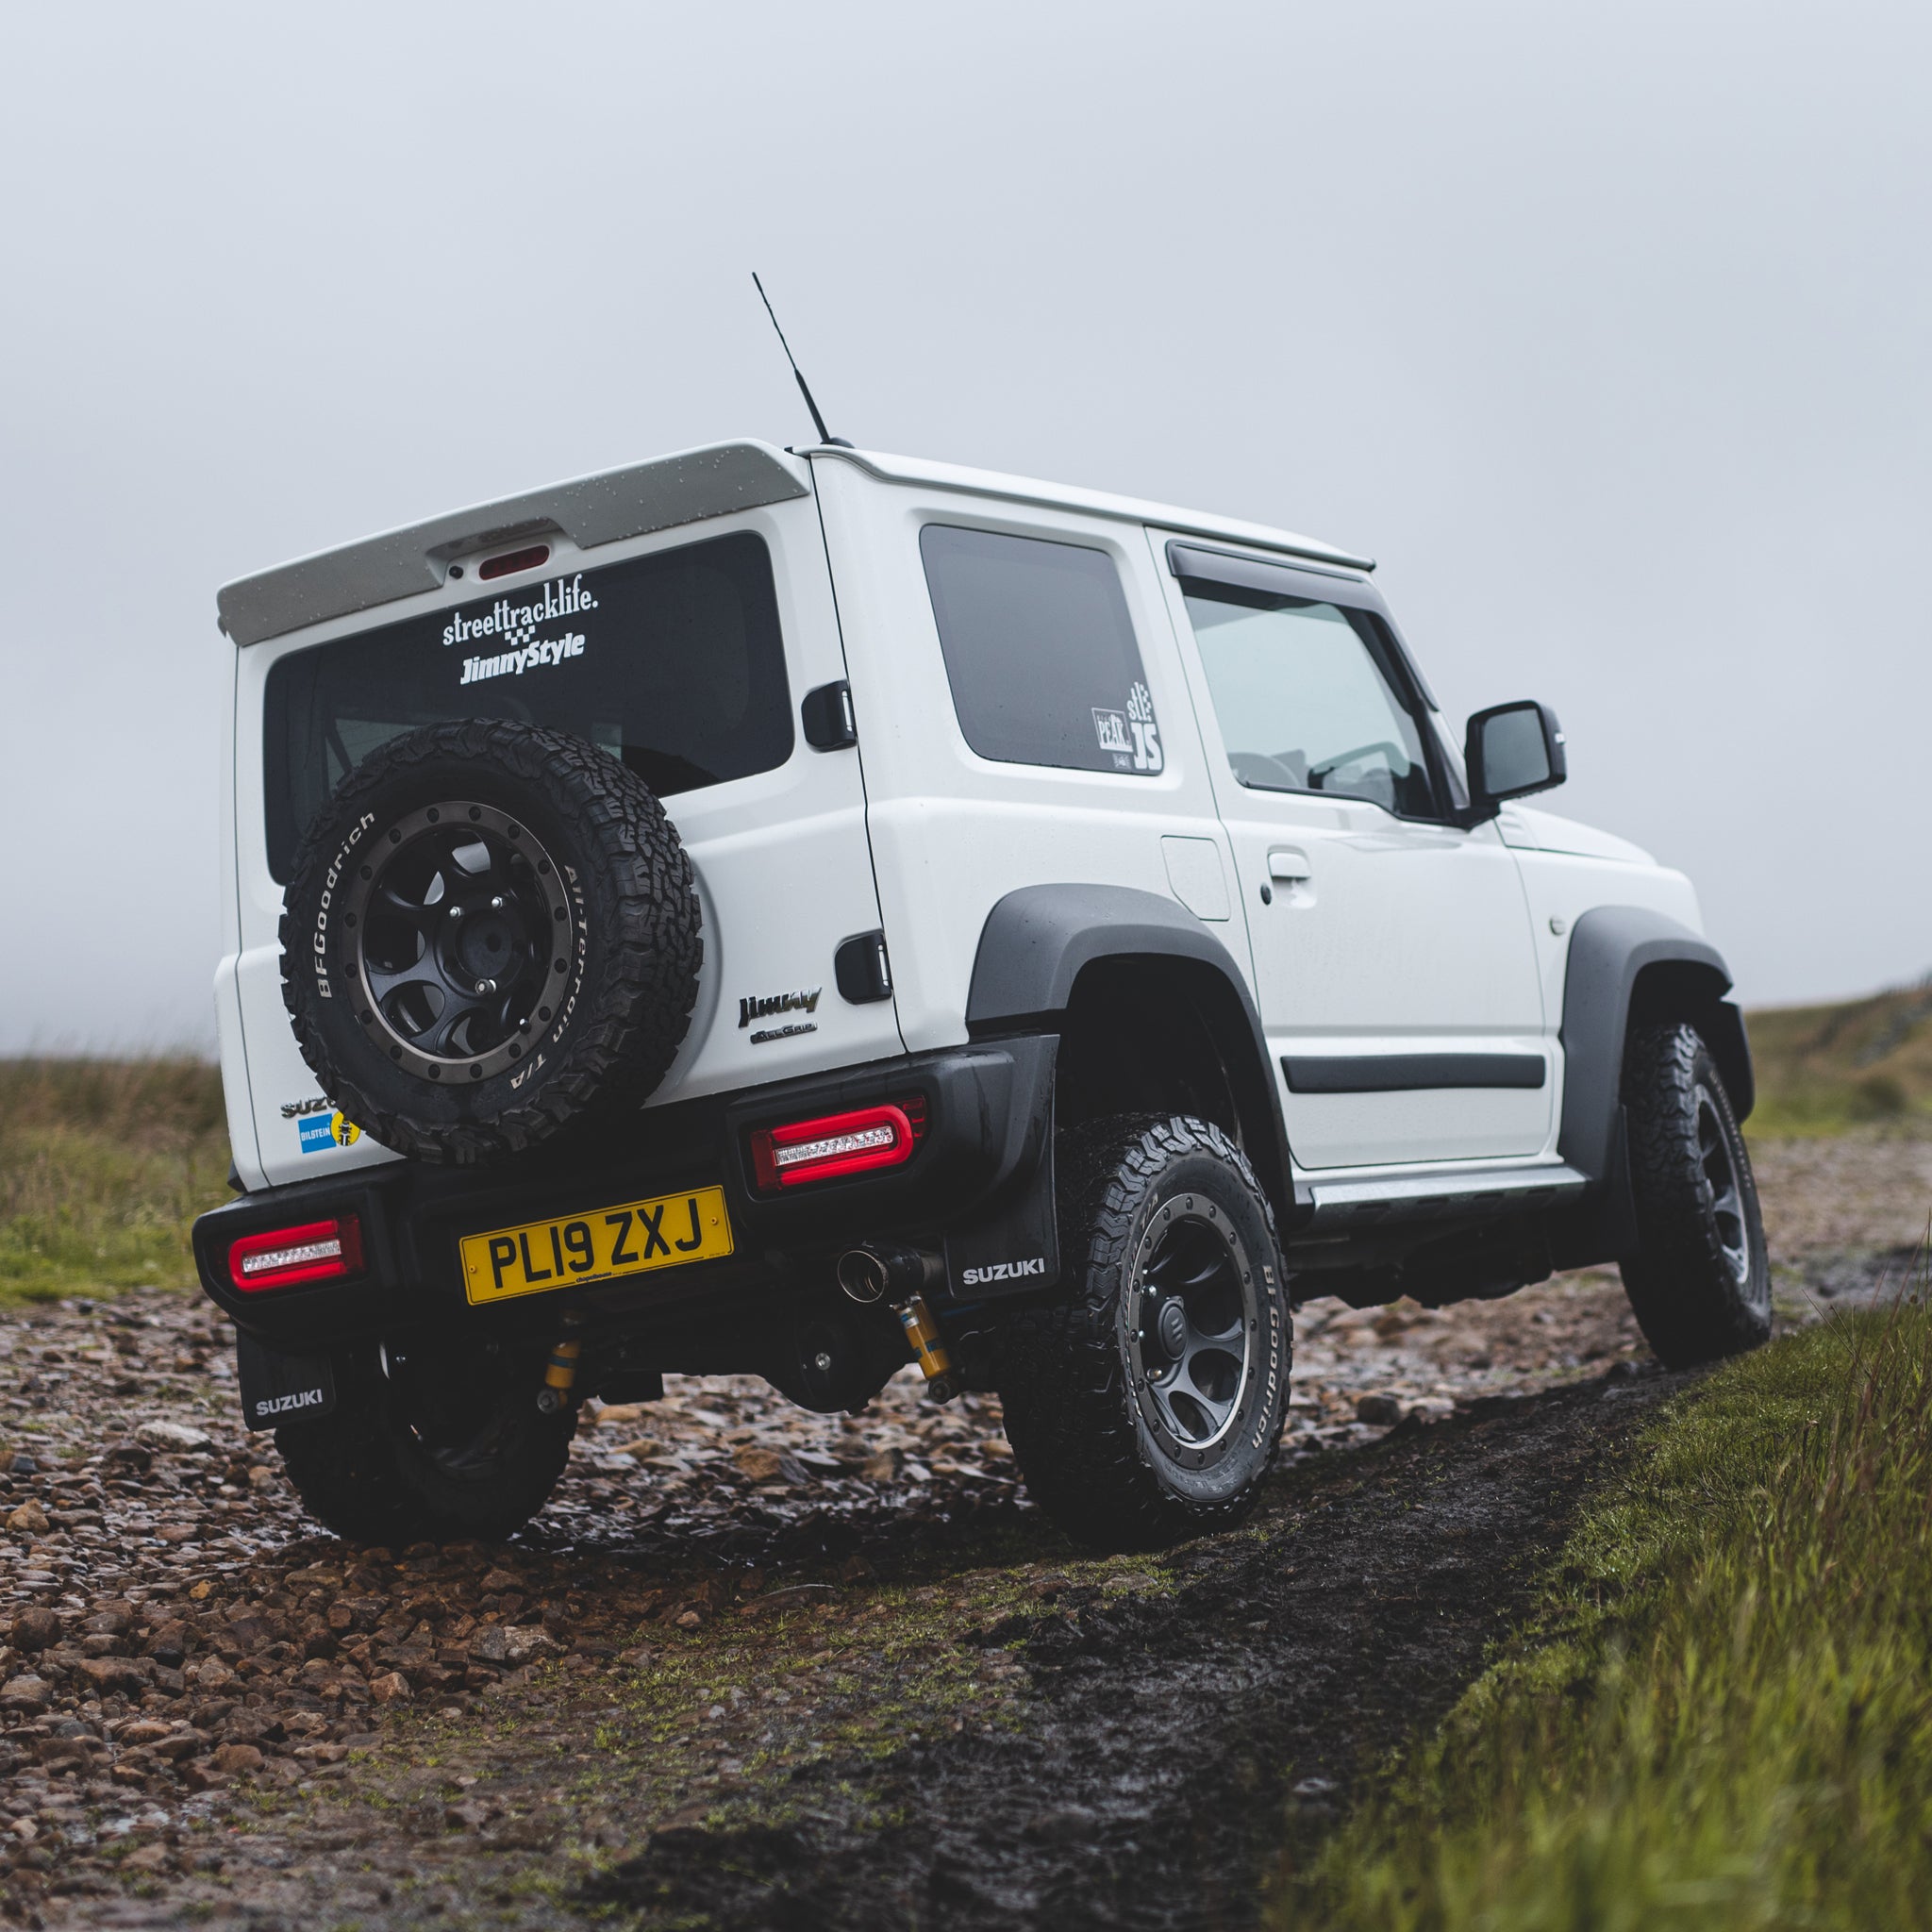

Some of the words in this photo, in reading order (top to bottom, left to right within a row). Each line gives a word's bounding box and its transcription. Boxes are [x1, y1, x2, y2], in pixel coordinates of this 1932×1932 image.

[442, 573, 599, 646] streettracklife.
[459, 632, 586, 685] JimnyStyle
[314, 812, 375, 998] BFGoodrich
[509, 1054, 547, 1090] T/A
[300, 1126, 331, 1141] BILSTEIN
[488, 1221, 595, 1290] PL19
[605, 1198, 703, 1266] ZXJ
[962, 1257, 1045, 1285] SUZUKI
[256, 1389, 323, 1416] SUZUKI
